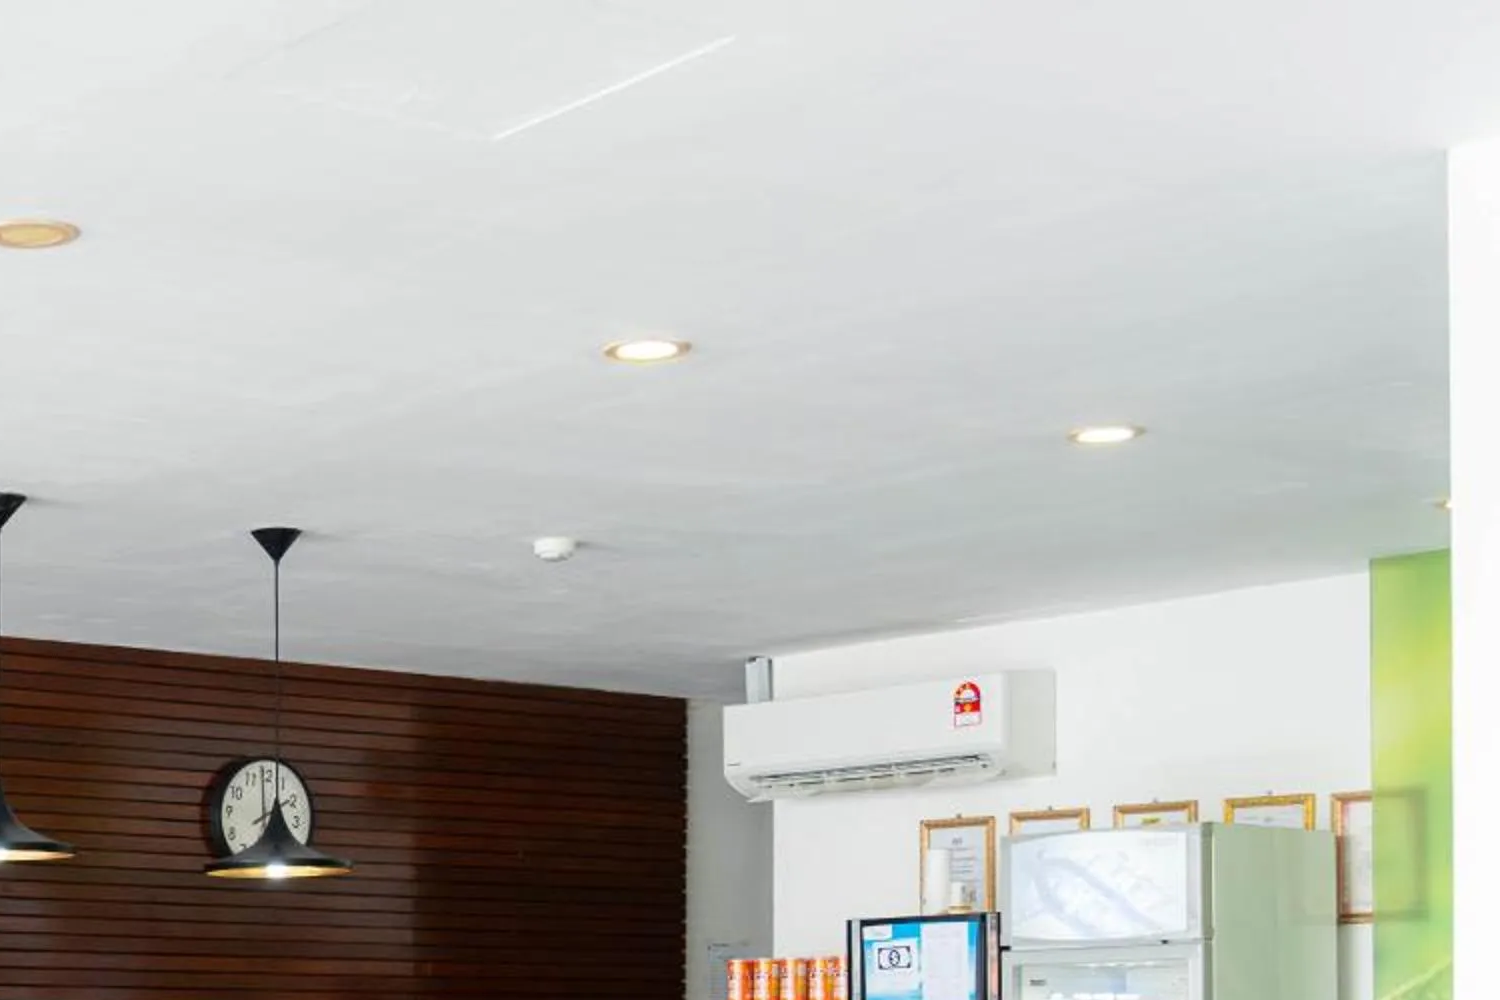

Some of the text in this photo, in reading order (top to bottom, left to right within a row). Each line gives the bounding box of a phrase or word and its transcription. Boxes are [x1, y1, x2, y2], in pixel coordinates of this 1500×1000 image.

[245, 771, 257, 787] 11
[230, 785, 243, 800] 10
[289, 793, 297, 808] 2
[225, 805, 233, 817] 9
[291, 815, 301, 828] 3
[227, 826, 236, 840] 8
